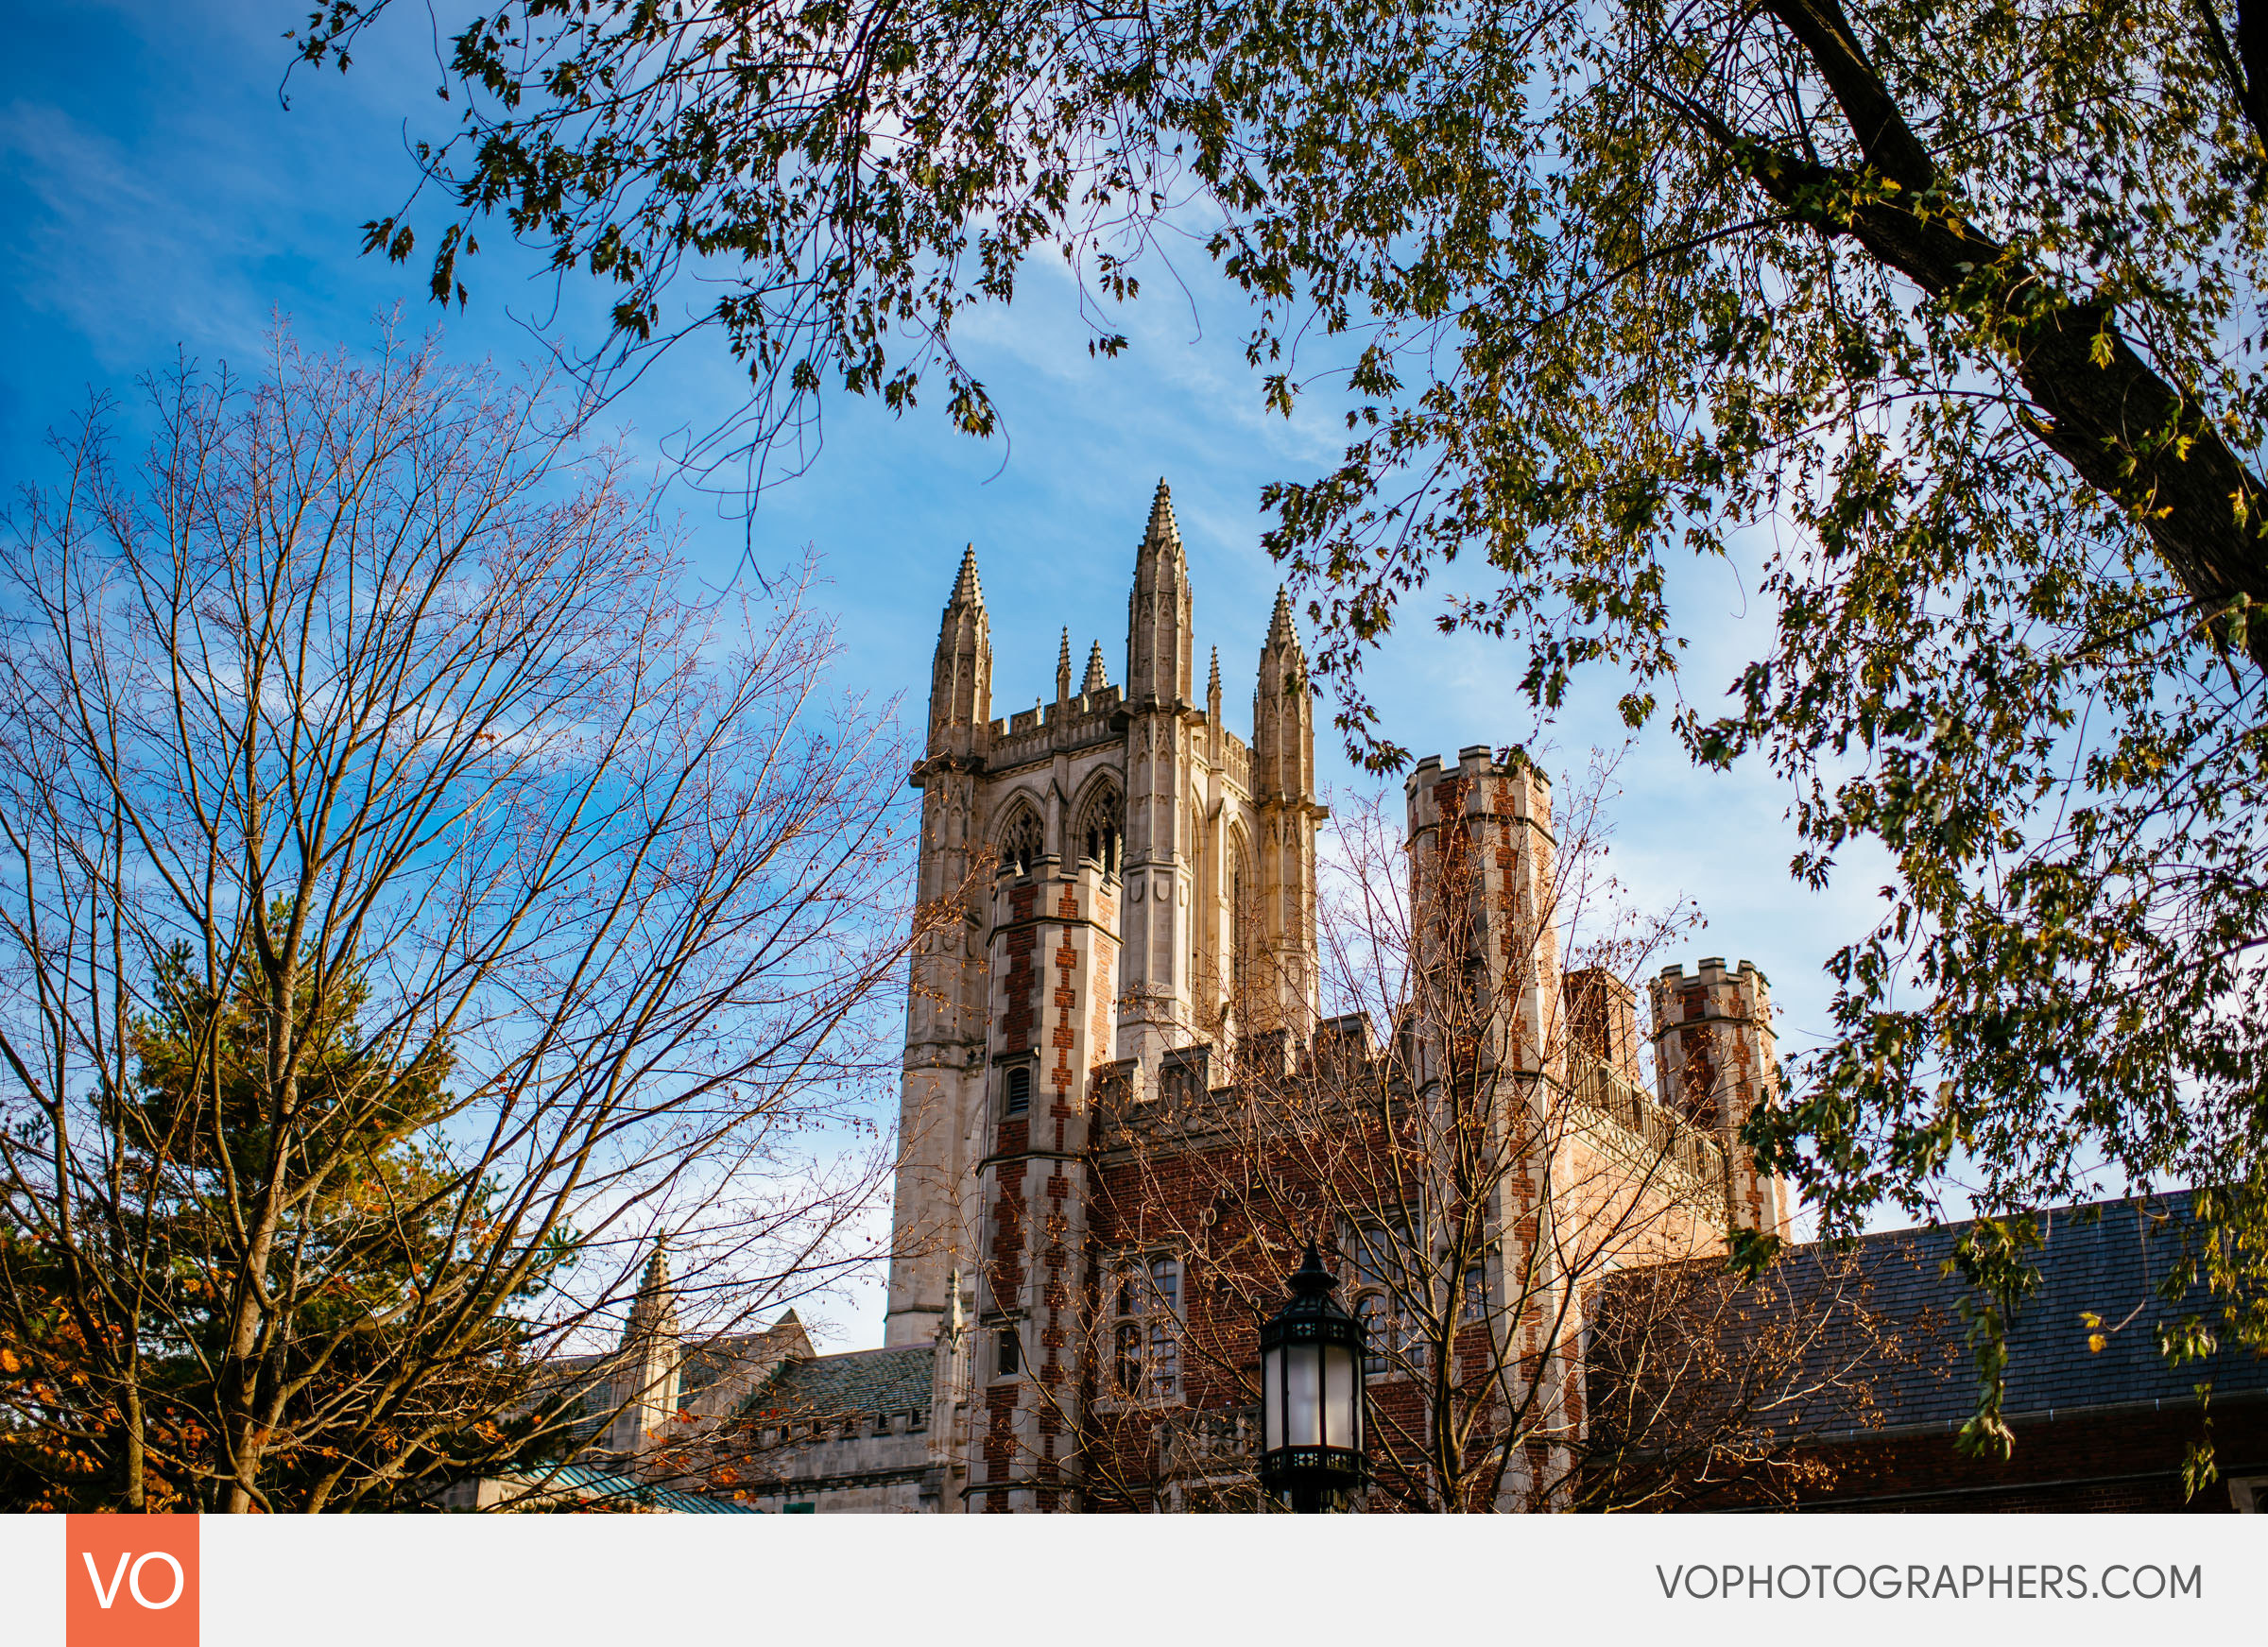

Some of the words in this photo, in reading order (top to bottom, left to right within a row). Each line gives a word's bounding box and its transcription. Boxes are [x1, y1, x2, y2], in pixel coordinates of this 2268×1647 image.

[1294, 1192, 1307, 1210] 2
[1198, 1208, 1217, 1227] 10
[1221, 1287, 1233, 1310] 7
